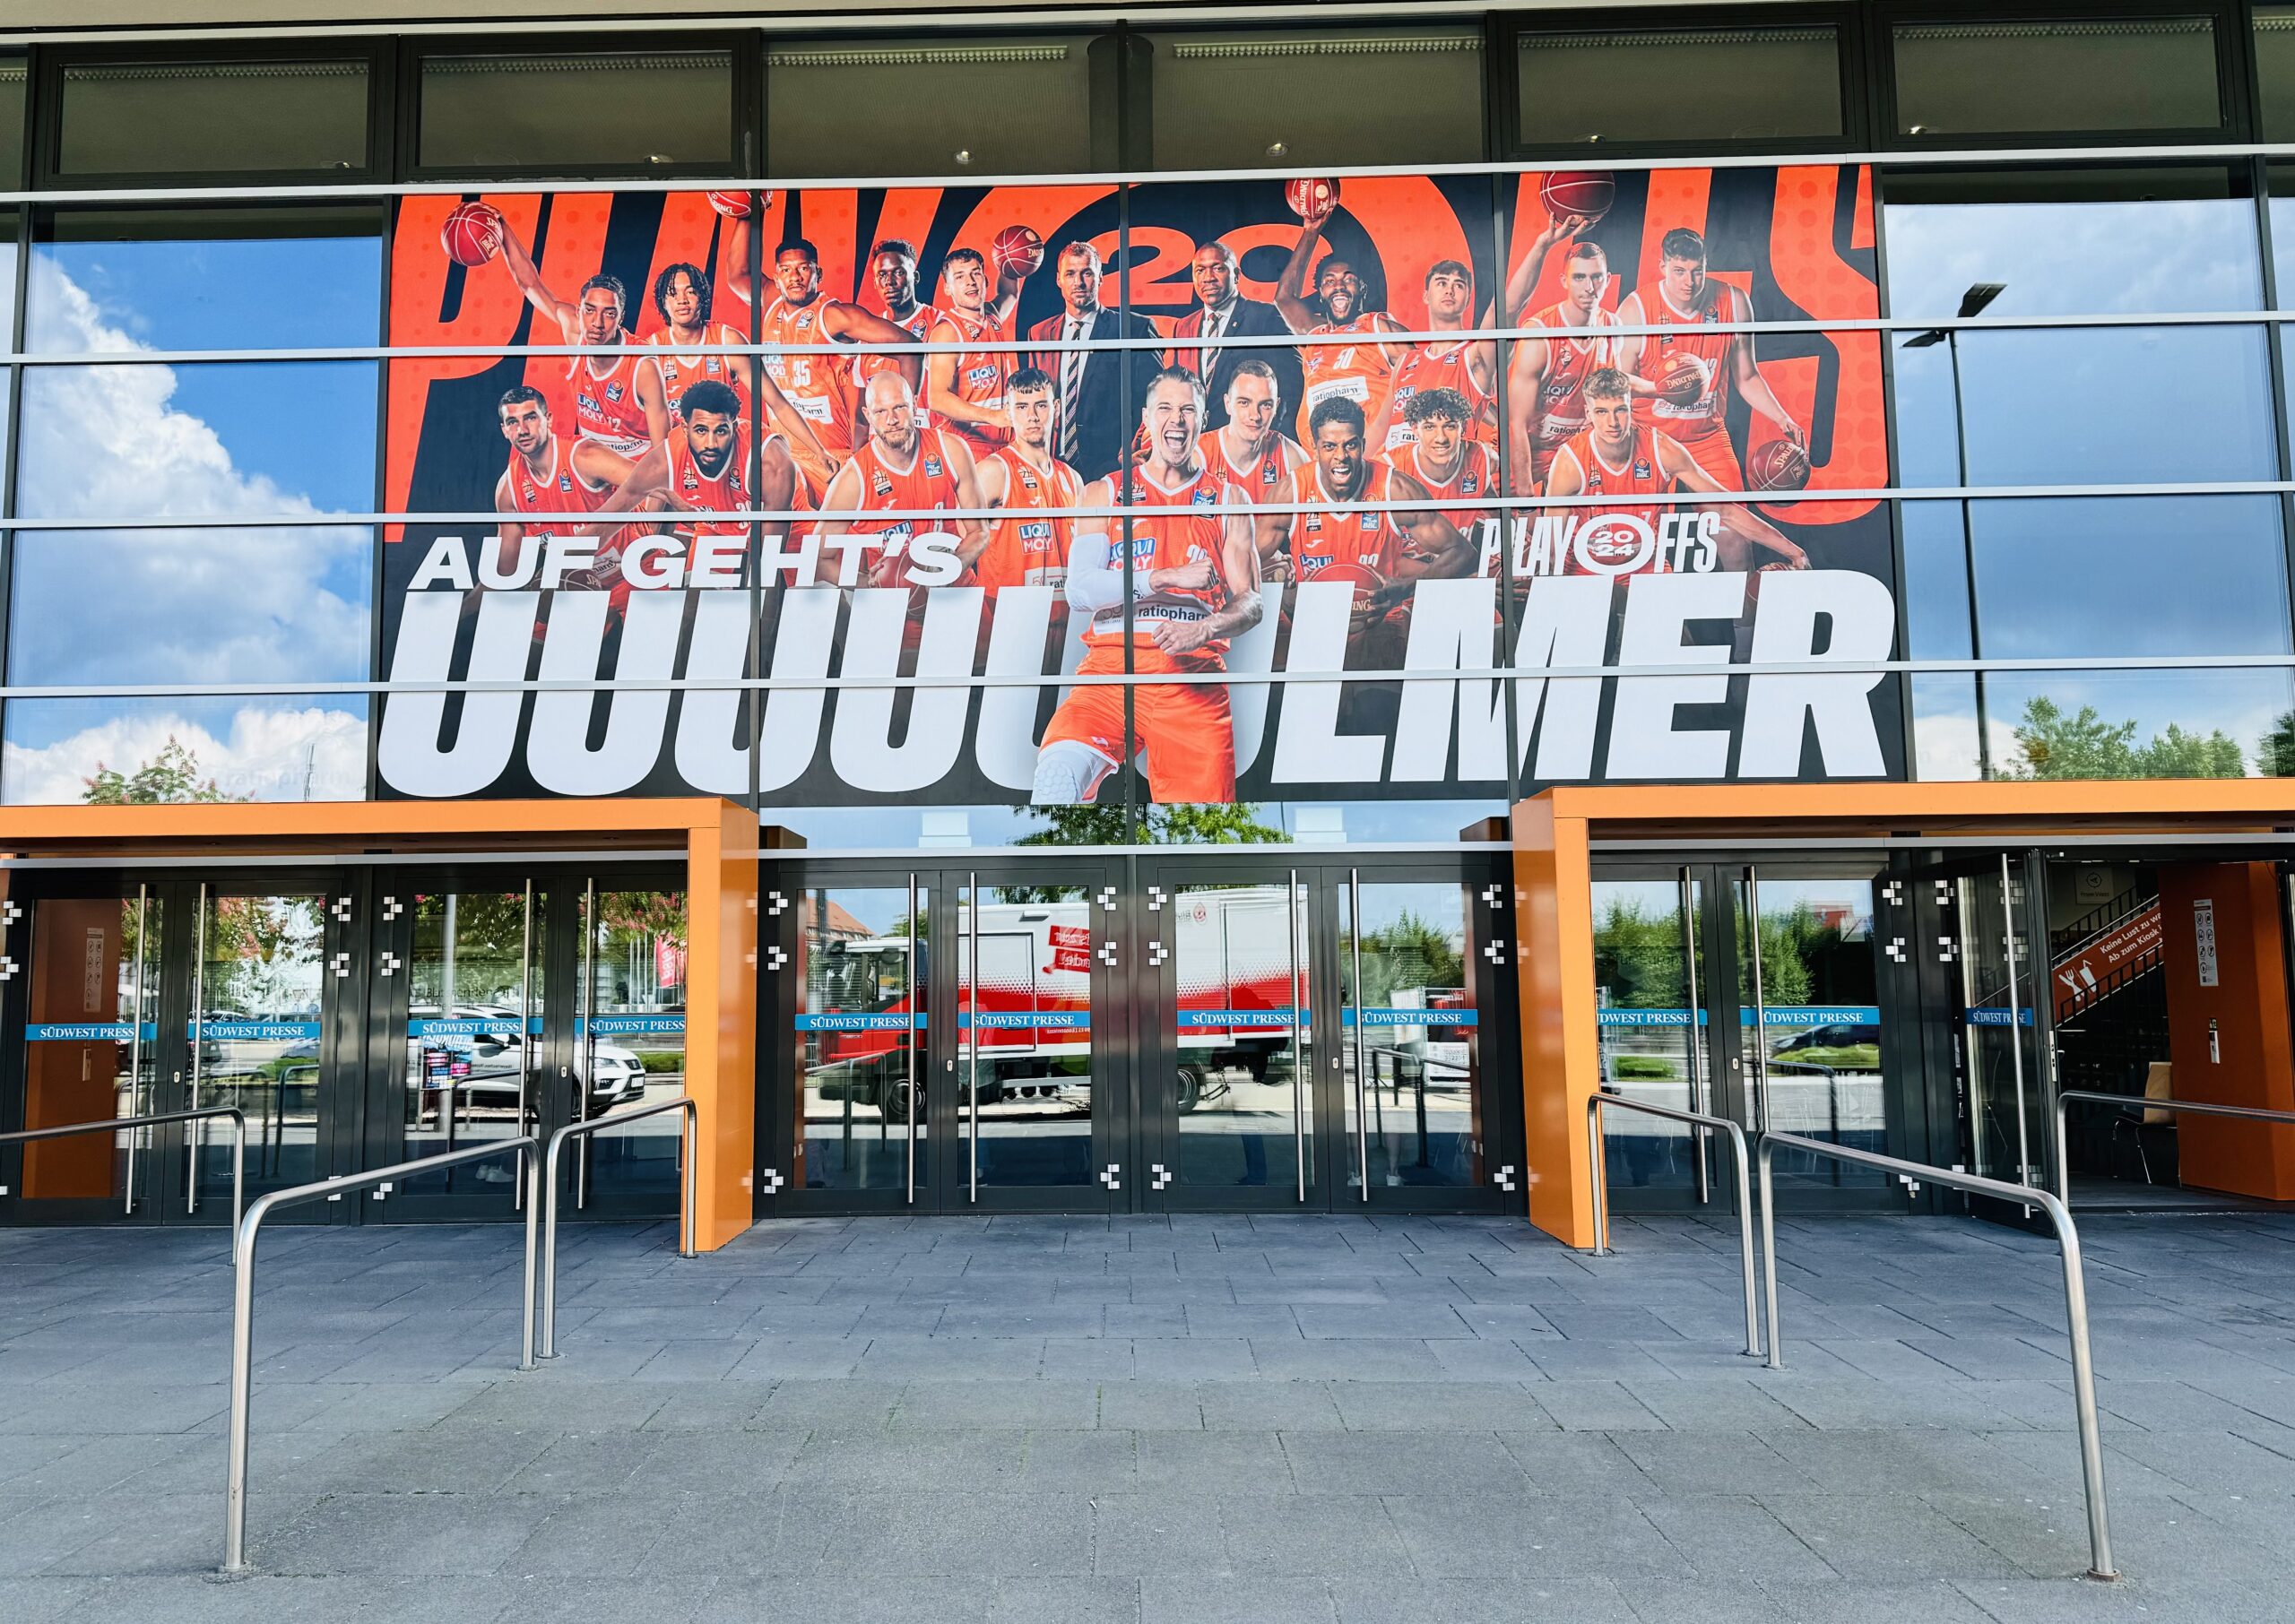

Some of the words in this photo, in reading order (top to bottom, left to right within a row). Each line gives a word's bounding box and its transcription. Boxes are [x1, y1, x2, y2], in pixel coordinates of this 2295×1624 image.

[792, 360, 811, 387] 35
[578, 406, 606, 423] MOLY
[1020, 523, 1051, 539] LIQUI
[1595, 530, 1635, 543] 20
[1477, 512, 1721, 579] PLAYOFFS
[1594, 543, 1636, 557] 24
[406, 535, 601, 591] AUF
[620, 531, 964, 590] GEHT'S
[2100, 937, 2123, 955] Keine
[2121, 926, 2141, 941] Lust
[2140, 920, 2151, 930] zu
[2108, 952, 2120, 963] Ab
[2120, 941, 2138, 955] zum
[2136, 929, 2160, 946] Kiosk
[810, 1015, 868, 1028] SÜDWEST
[974, 1015, 1030, 1026] SÜDWEST
[1032, 1015, 1075, 1025] PRESSE
[1191, 1011, 1250, 1024] SÜDWEST
[1251, 1013, 1295, 1024] PRESSE
[1420, 1013, 1462, 1024] PRESSE
[1646, 1014, 1692, 1024] PRESSE
[1763, 1011, 1817, 1023] ÜDWEST
[1819, 1013, 1864, 1024] PRESSE
[1972, 1010, 2003, 1023] SÜDWEST
[2003, 1013, 2026, 1024] PRSE
[39, 1025, 98, 1038] SÜDWEST
[100, 1026, 134, 1038] PRESS
[202, 1024, 260, 1038] SÜDWEST
[262, 1025, 305, 1037] PRESSE
[422, 1021, 481, 1033] SÜDWEST
[589, 1019, 647, 1032] SÜDWEST
[649, 1020, 685, 1032] PRESS
